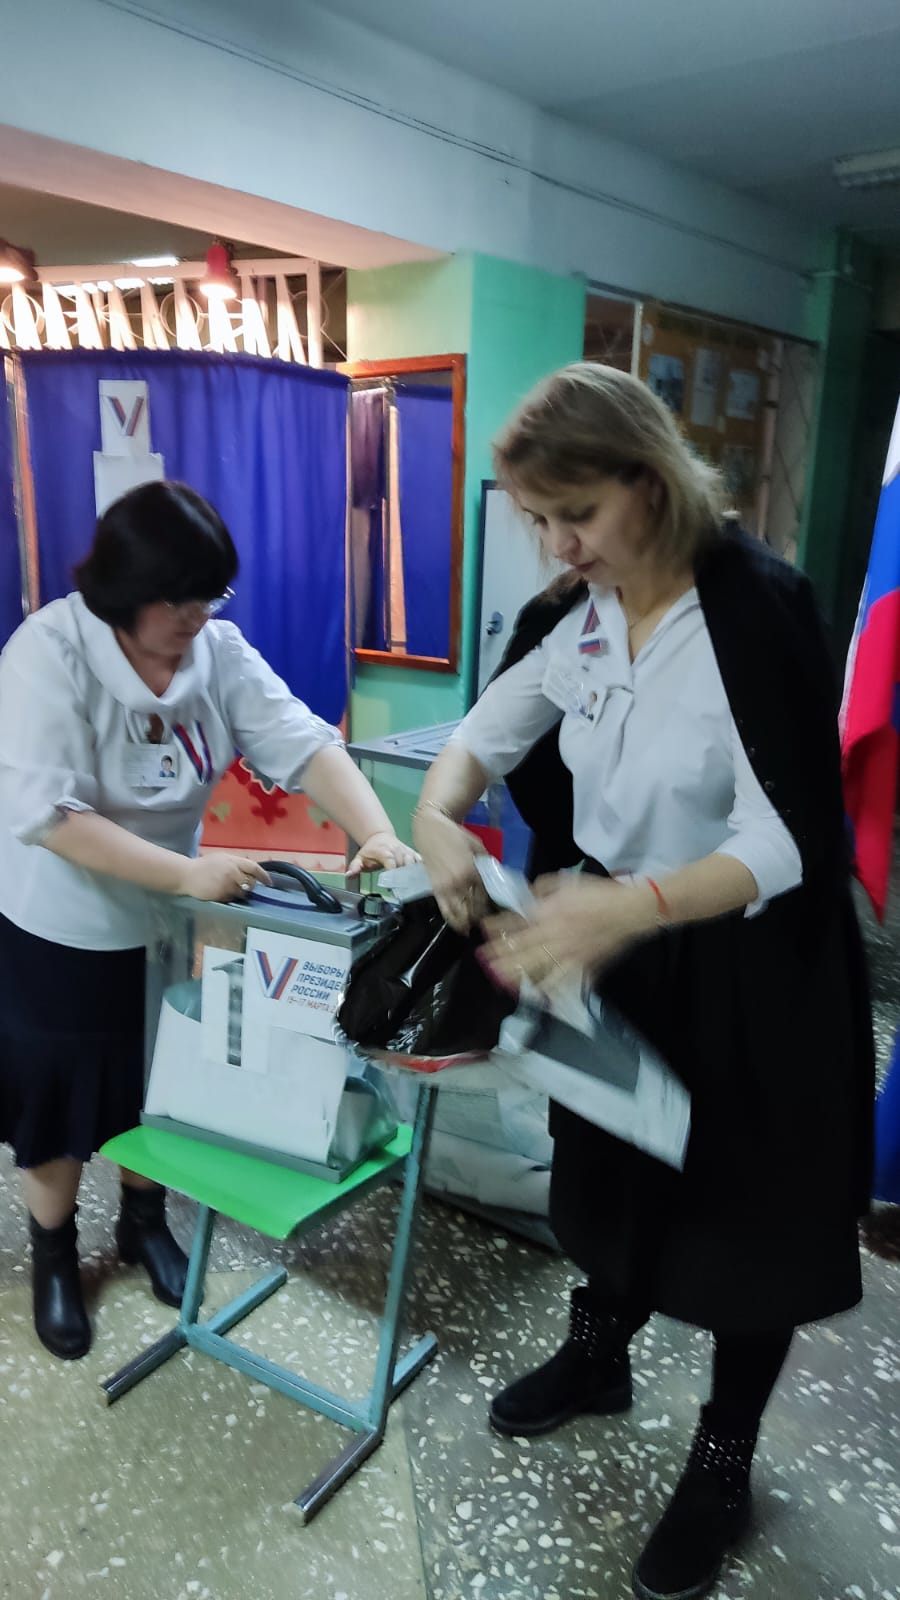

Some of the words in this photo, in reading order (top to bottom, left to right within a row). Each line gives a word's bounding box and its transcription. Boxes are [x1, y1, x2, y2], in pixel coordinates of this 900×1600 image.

[303, 961, 346, 978] ВЫБОРЫ
[296, 973, 343, 990] ПРЕЗИДЕ
[291, 984, 330, 1001] РОССИИ
